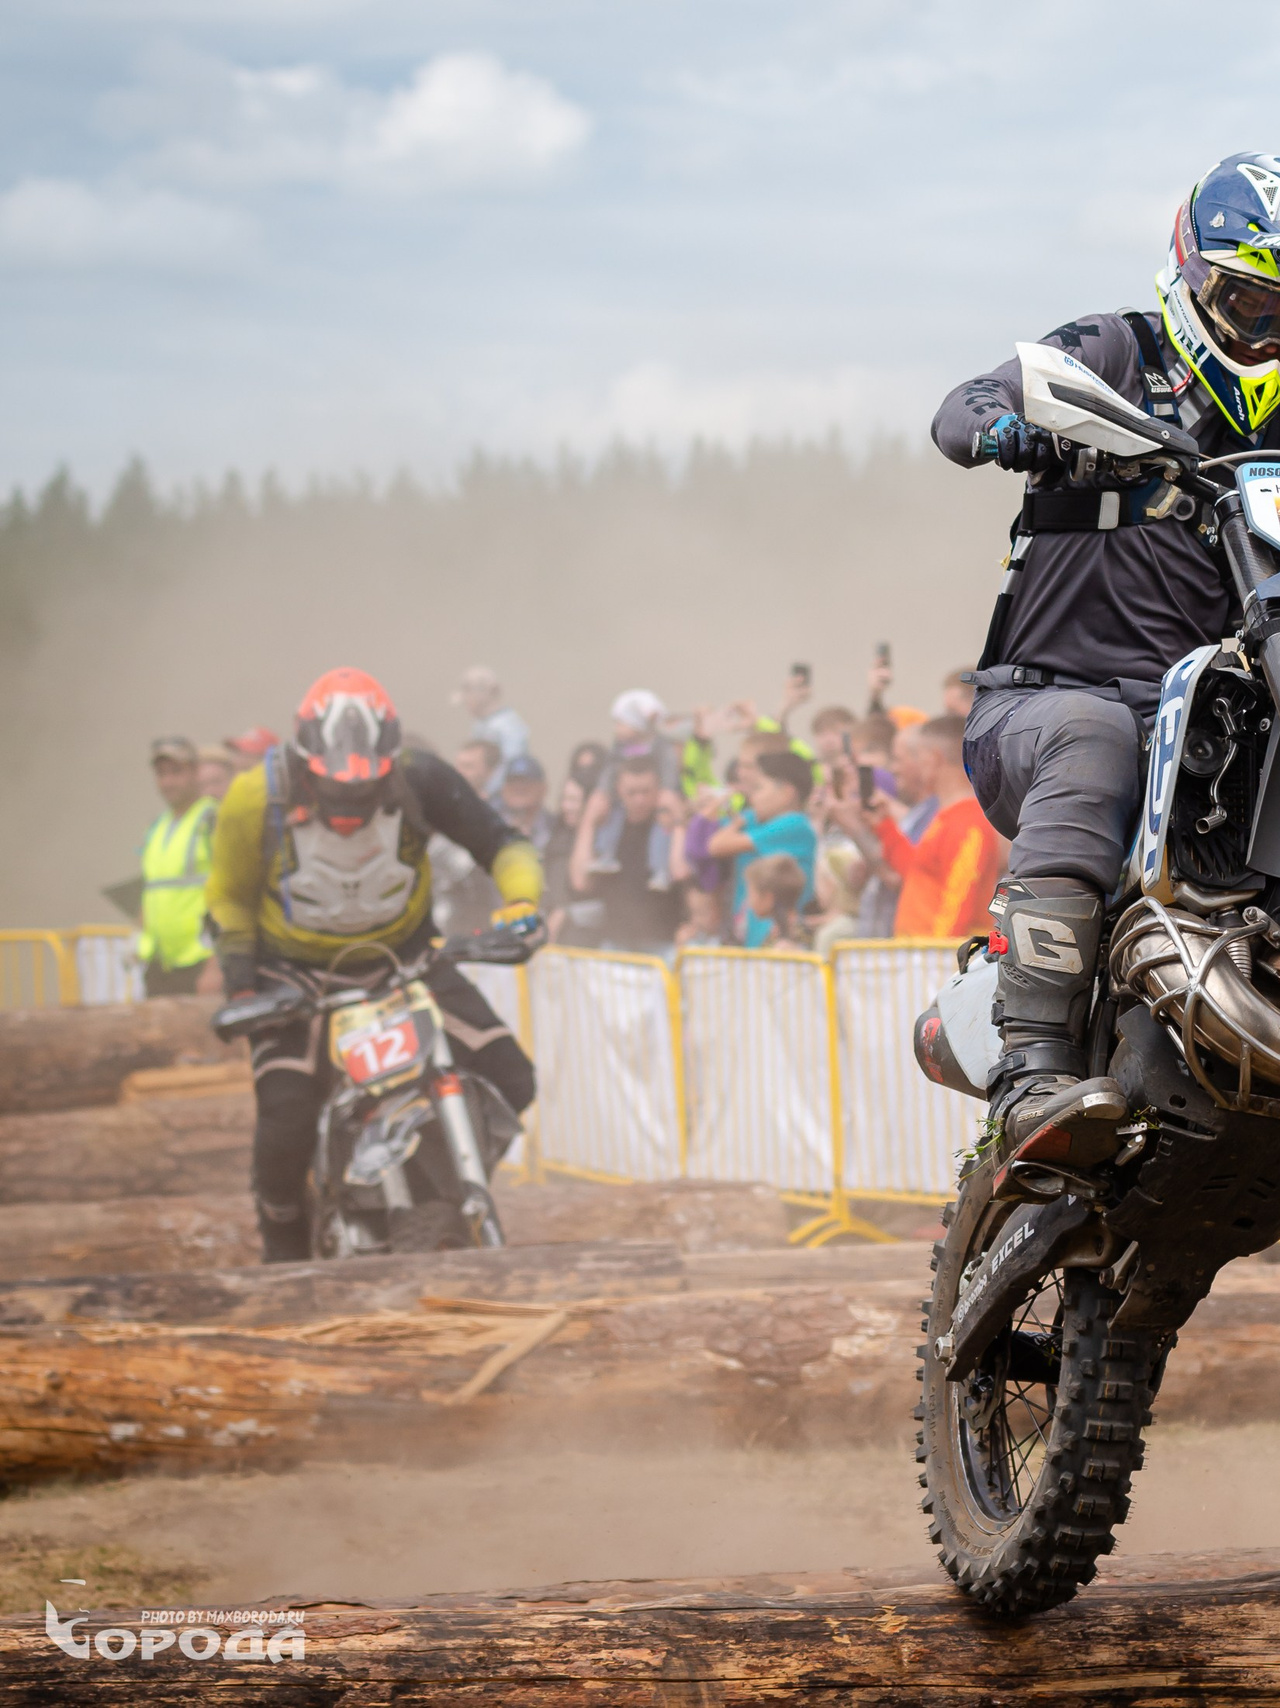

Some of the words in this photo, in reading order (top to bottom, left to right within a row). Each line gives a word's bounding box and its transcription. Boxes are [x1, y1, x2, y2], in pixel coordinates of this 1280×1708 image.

[1232, 385, 1246, 422] Airoh
[1012, 912, 1084, 975] G
[353, 1028, 412, 1075] 12
[991, 1221, 1035, 1275] EXCEL
